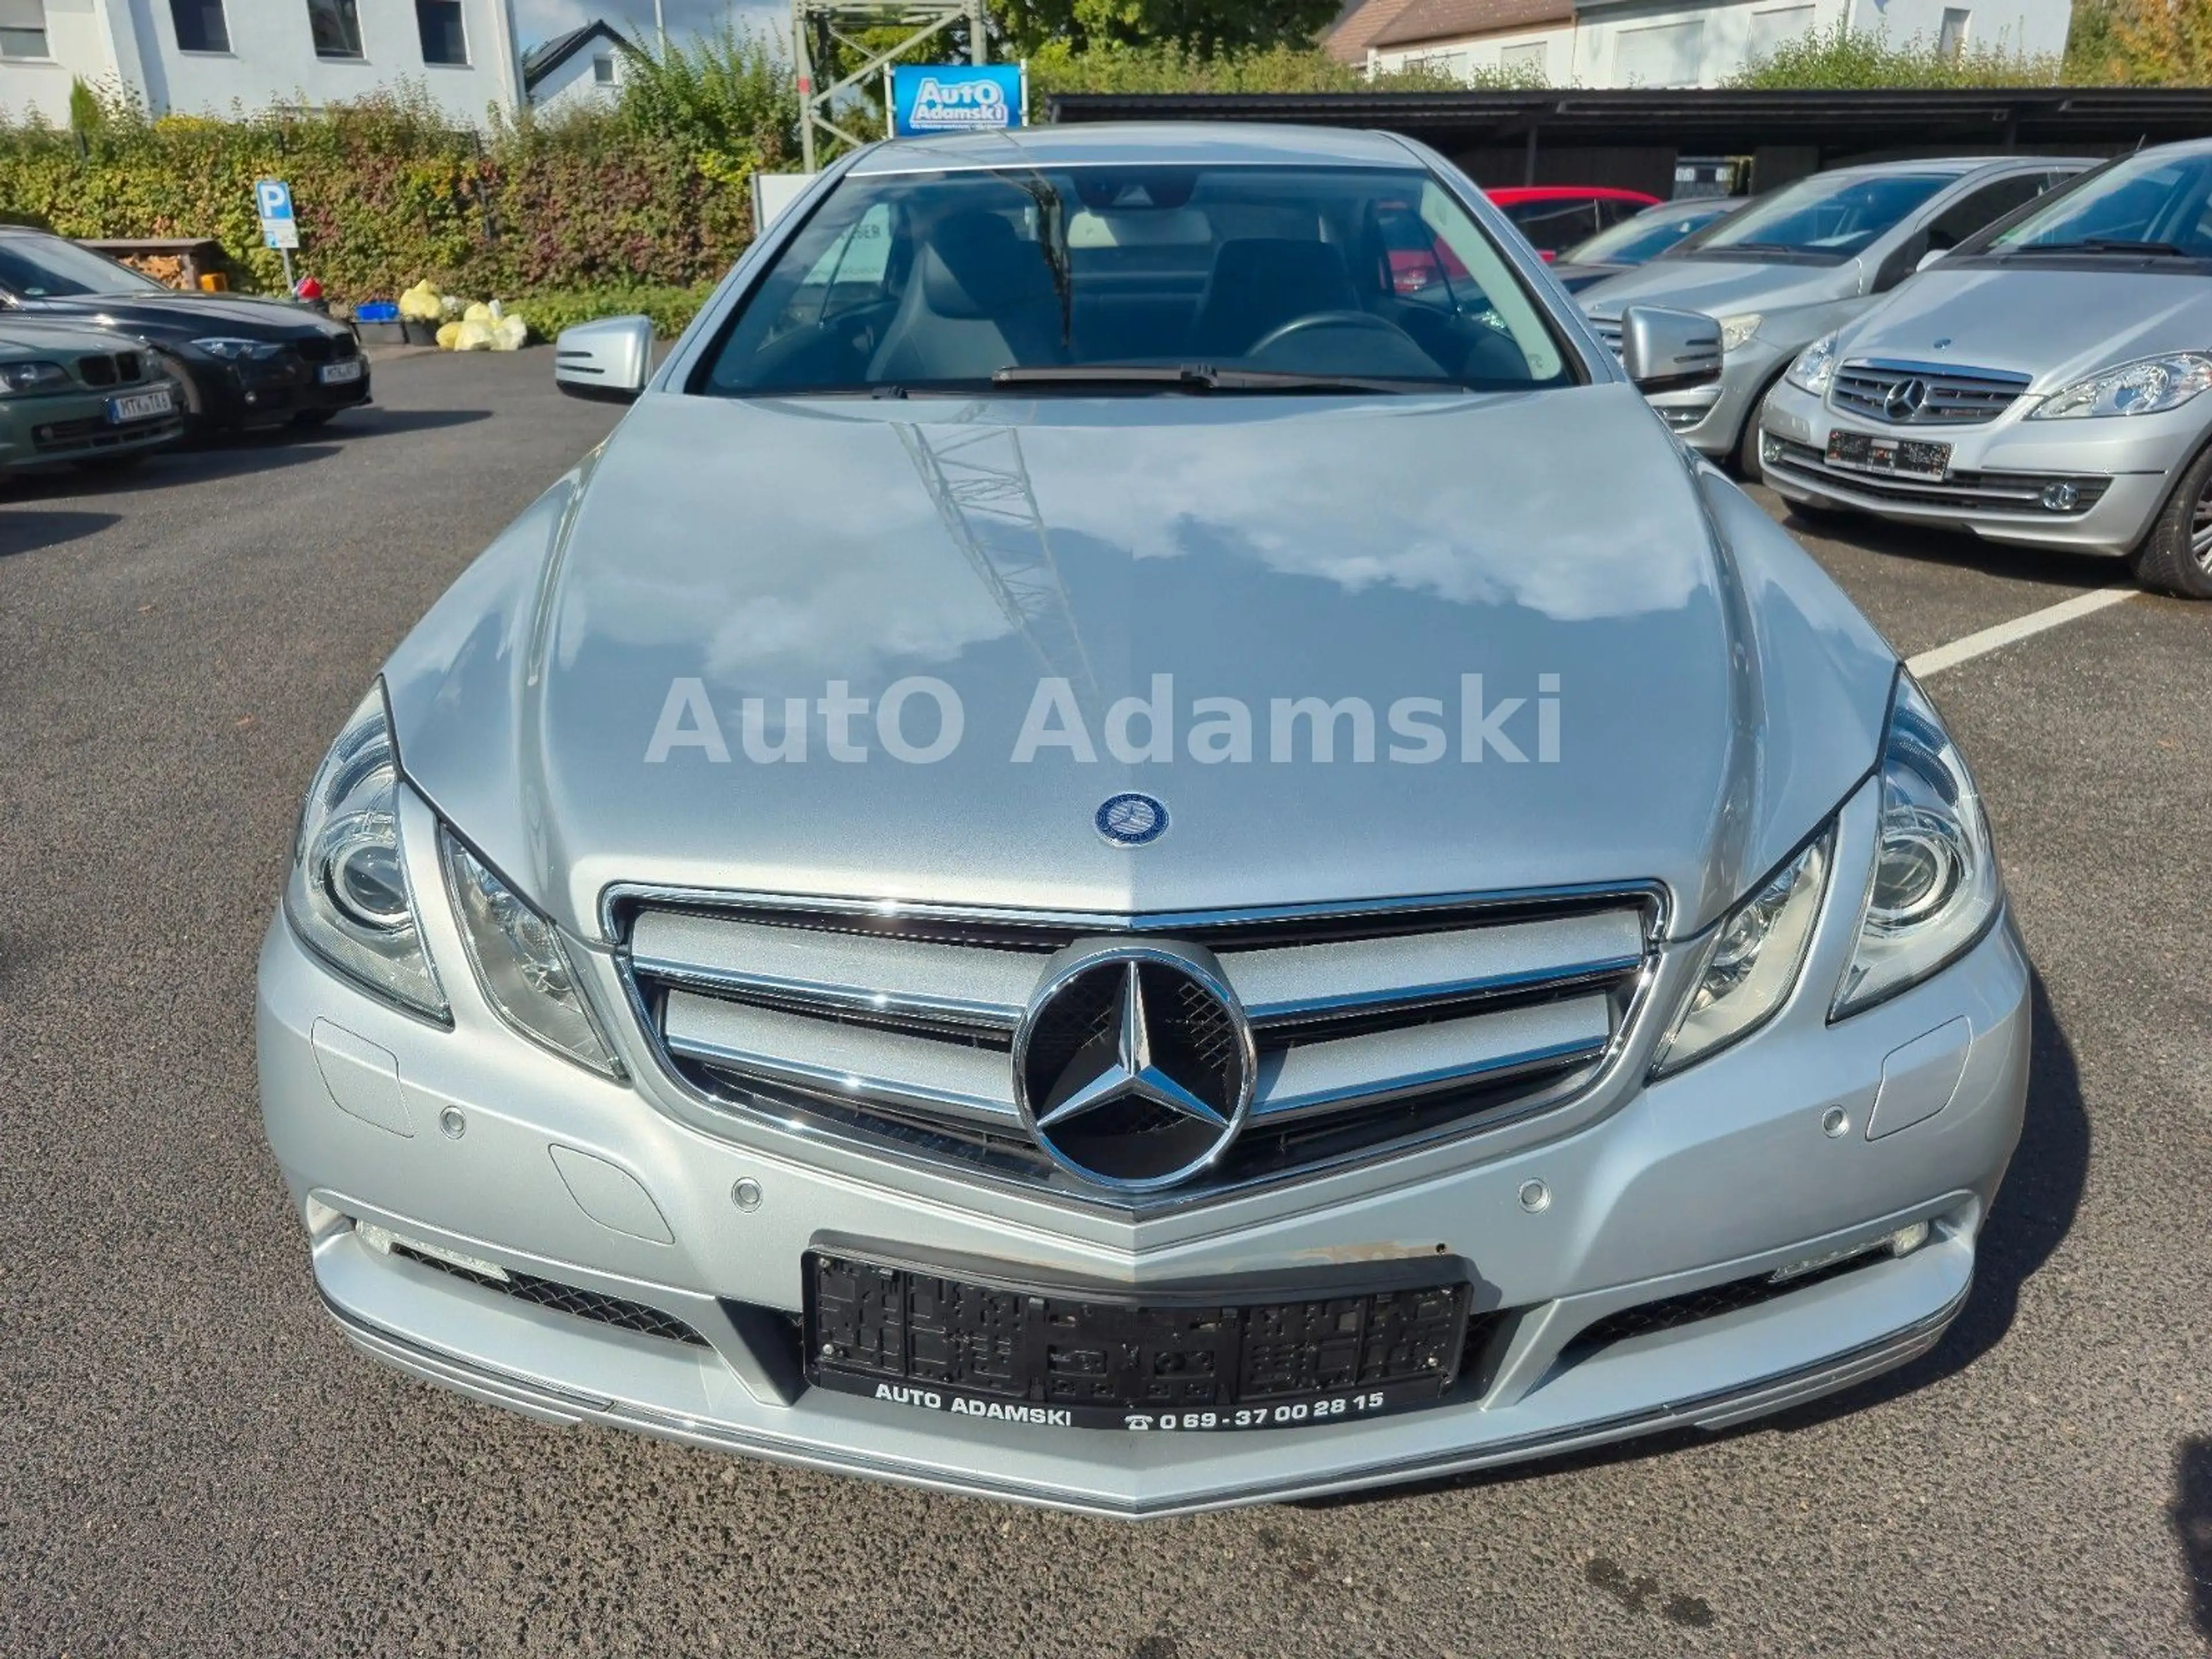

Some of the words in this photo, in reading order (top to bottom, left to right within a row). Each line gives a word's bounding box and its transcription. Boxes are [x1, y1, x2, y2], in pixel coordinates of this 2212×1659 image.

[919, 81, 999, 105] AutO
[916, 103, 1002, 120] Adamski
[260, 184, 286, 217] P
[875, 1383, 941, 1408] AUTO
[950, 1397, 1071, 1427] ADAMSKI
[1160, 1414, 1176, 1429] 0
[1183, 1412, 1217, 1428] 69
[1234, 1408, 1267, 1426] 37
[1275, 1404, 1308, 1422] 00
[1313, 1399, 1346, 1416] 28
[1353, 1392, 1384, 1410] 15
